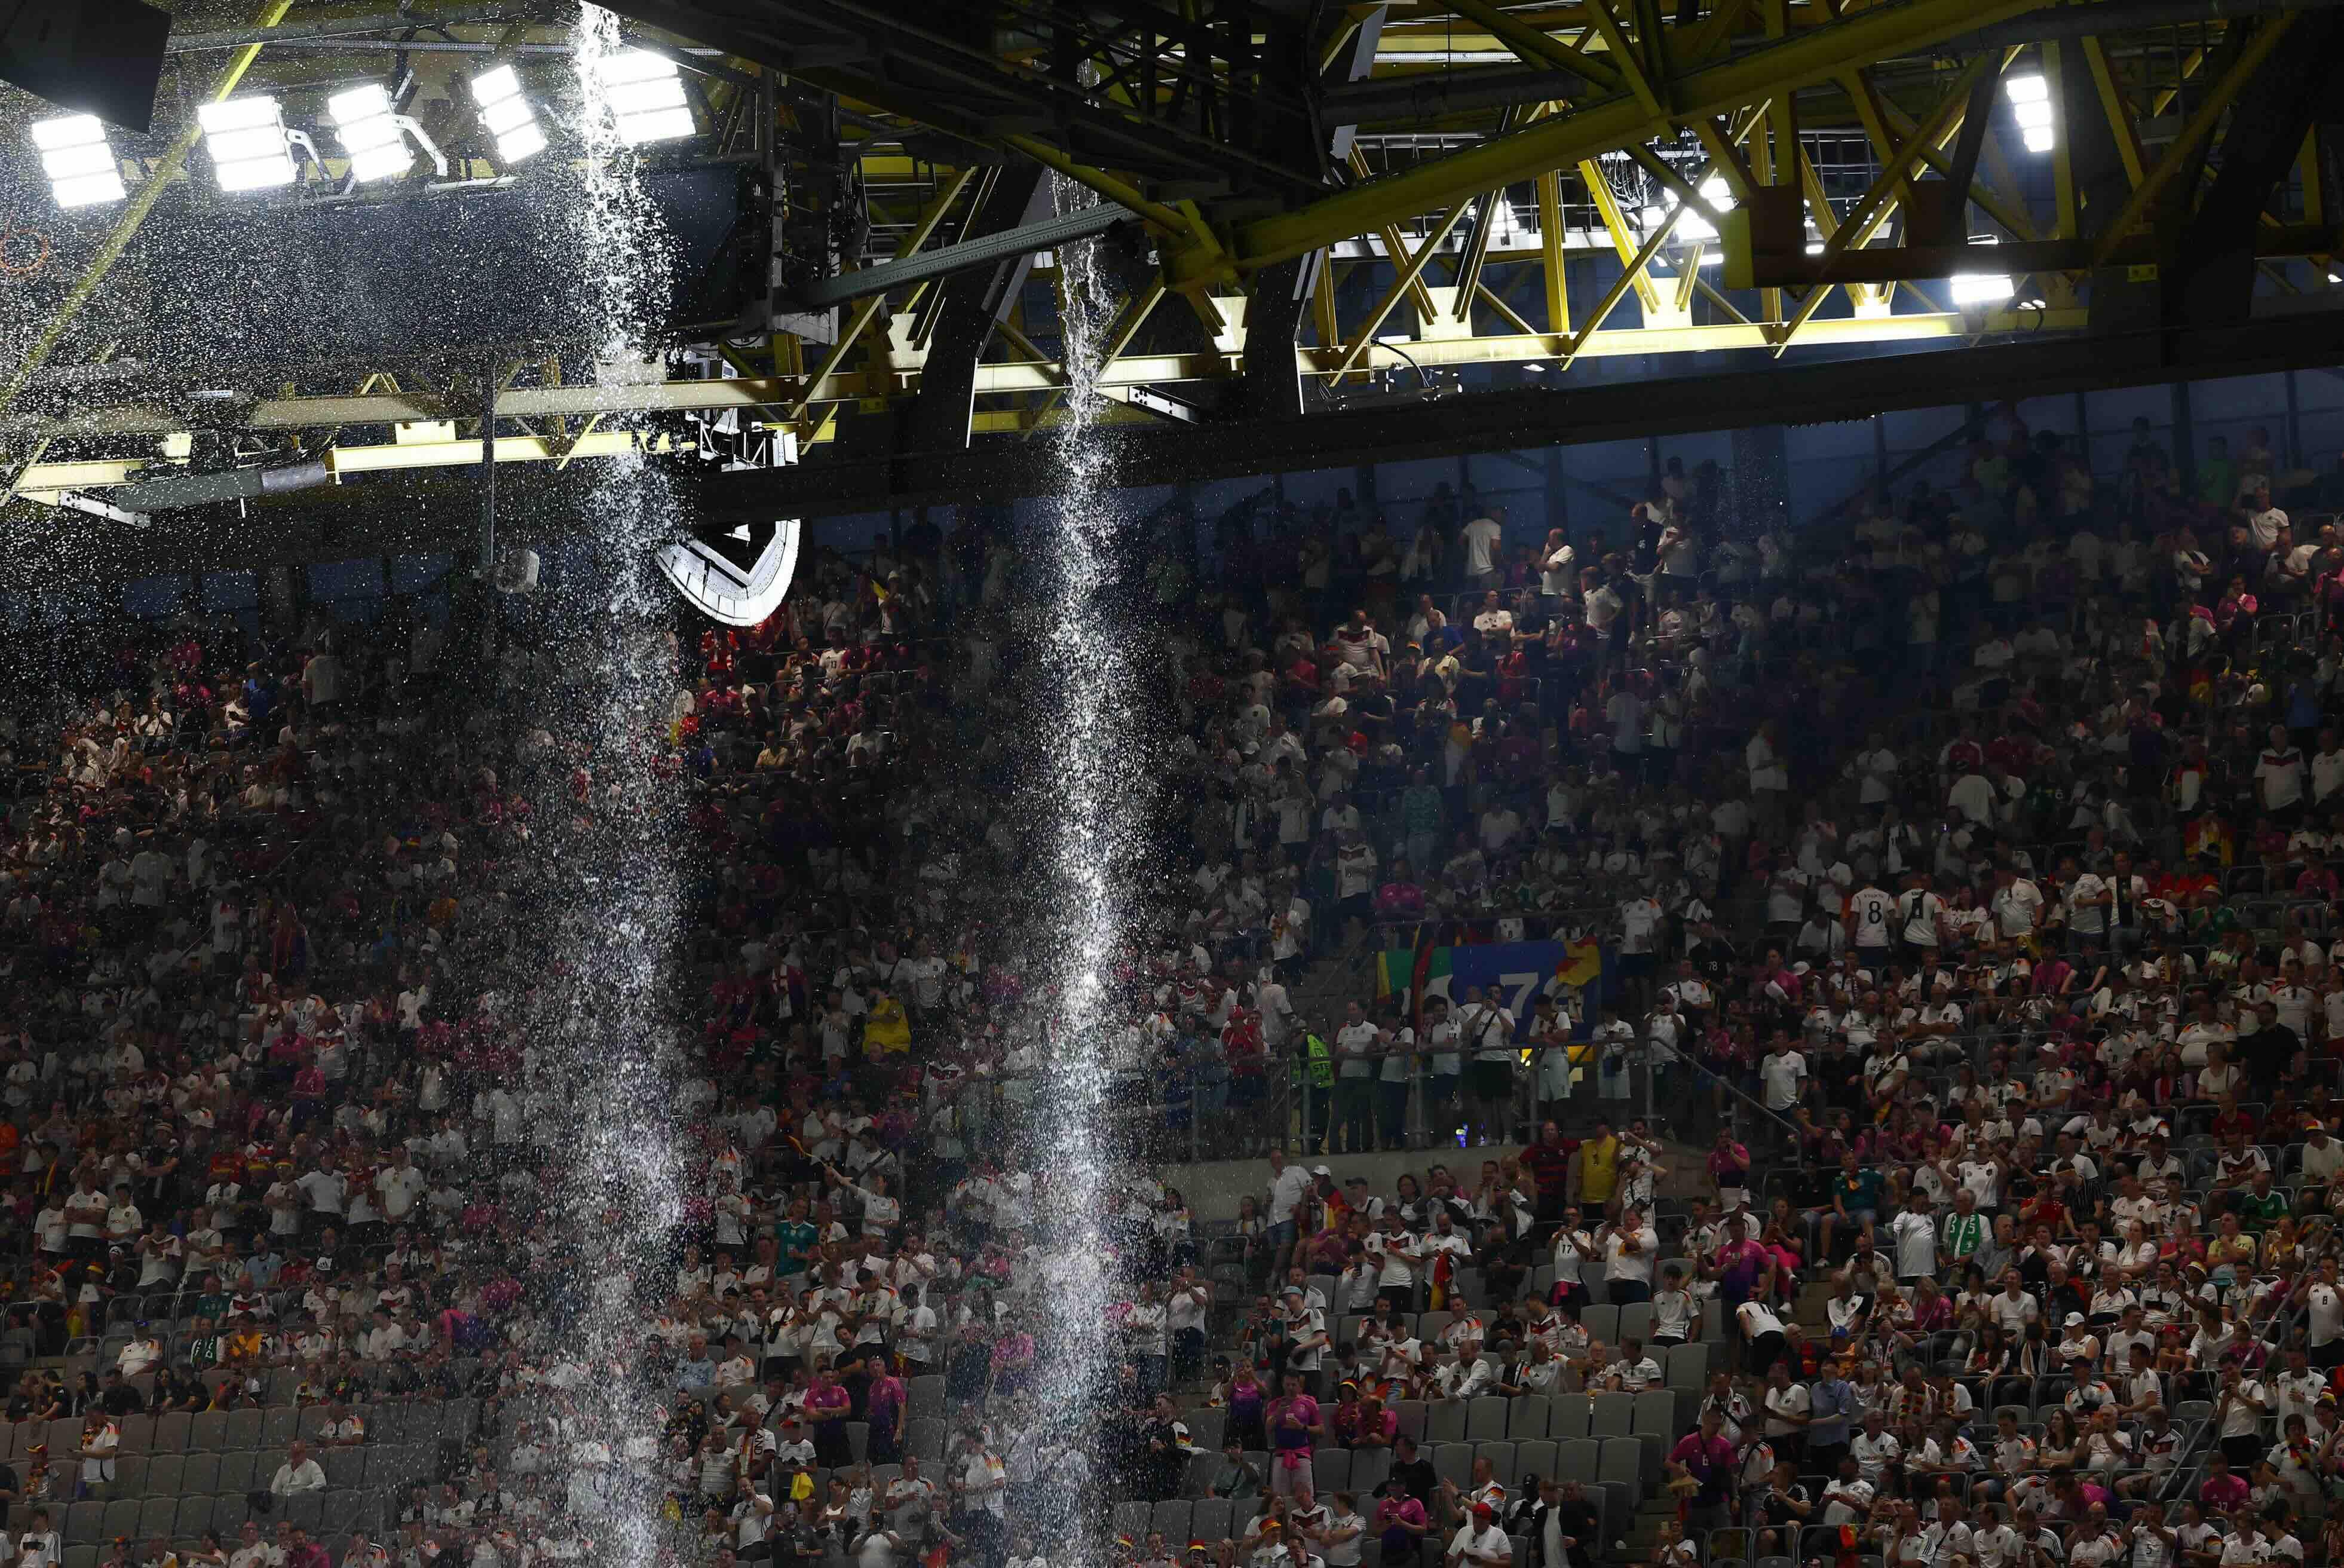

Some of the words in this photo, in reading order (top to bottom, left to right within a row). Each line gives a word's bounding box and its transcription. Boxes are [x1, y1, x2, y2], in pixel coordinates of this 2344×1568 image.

[1868, 901, 1882, 924] 8
[1562, 1244, 1572, 1254] 17
[1702, 1453, 1709, 1466] 6
[2146, 1543, 2153, 1555] 5
